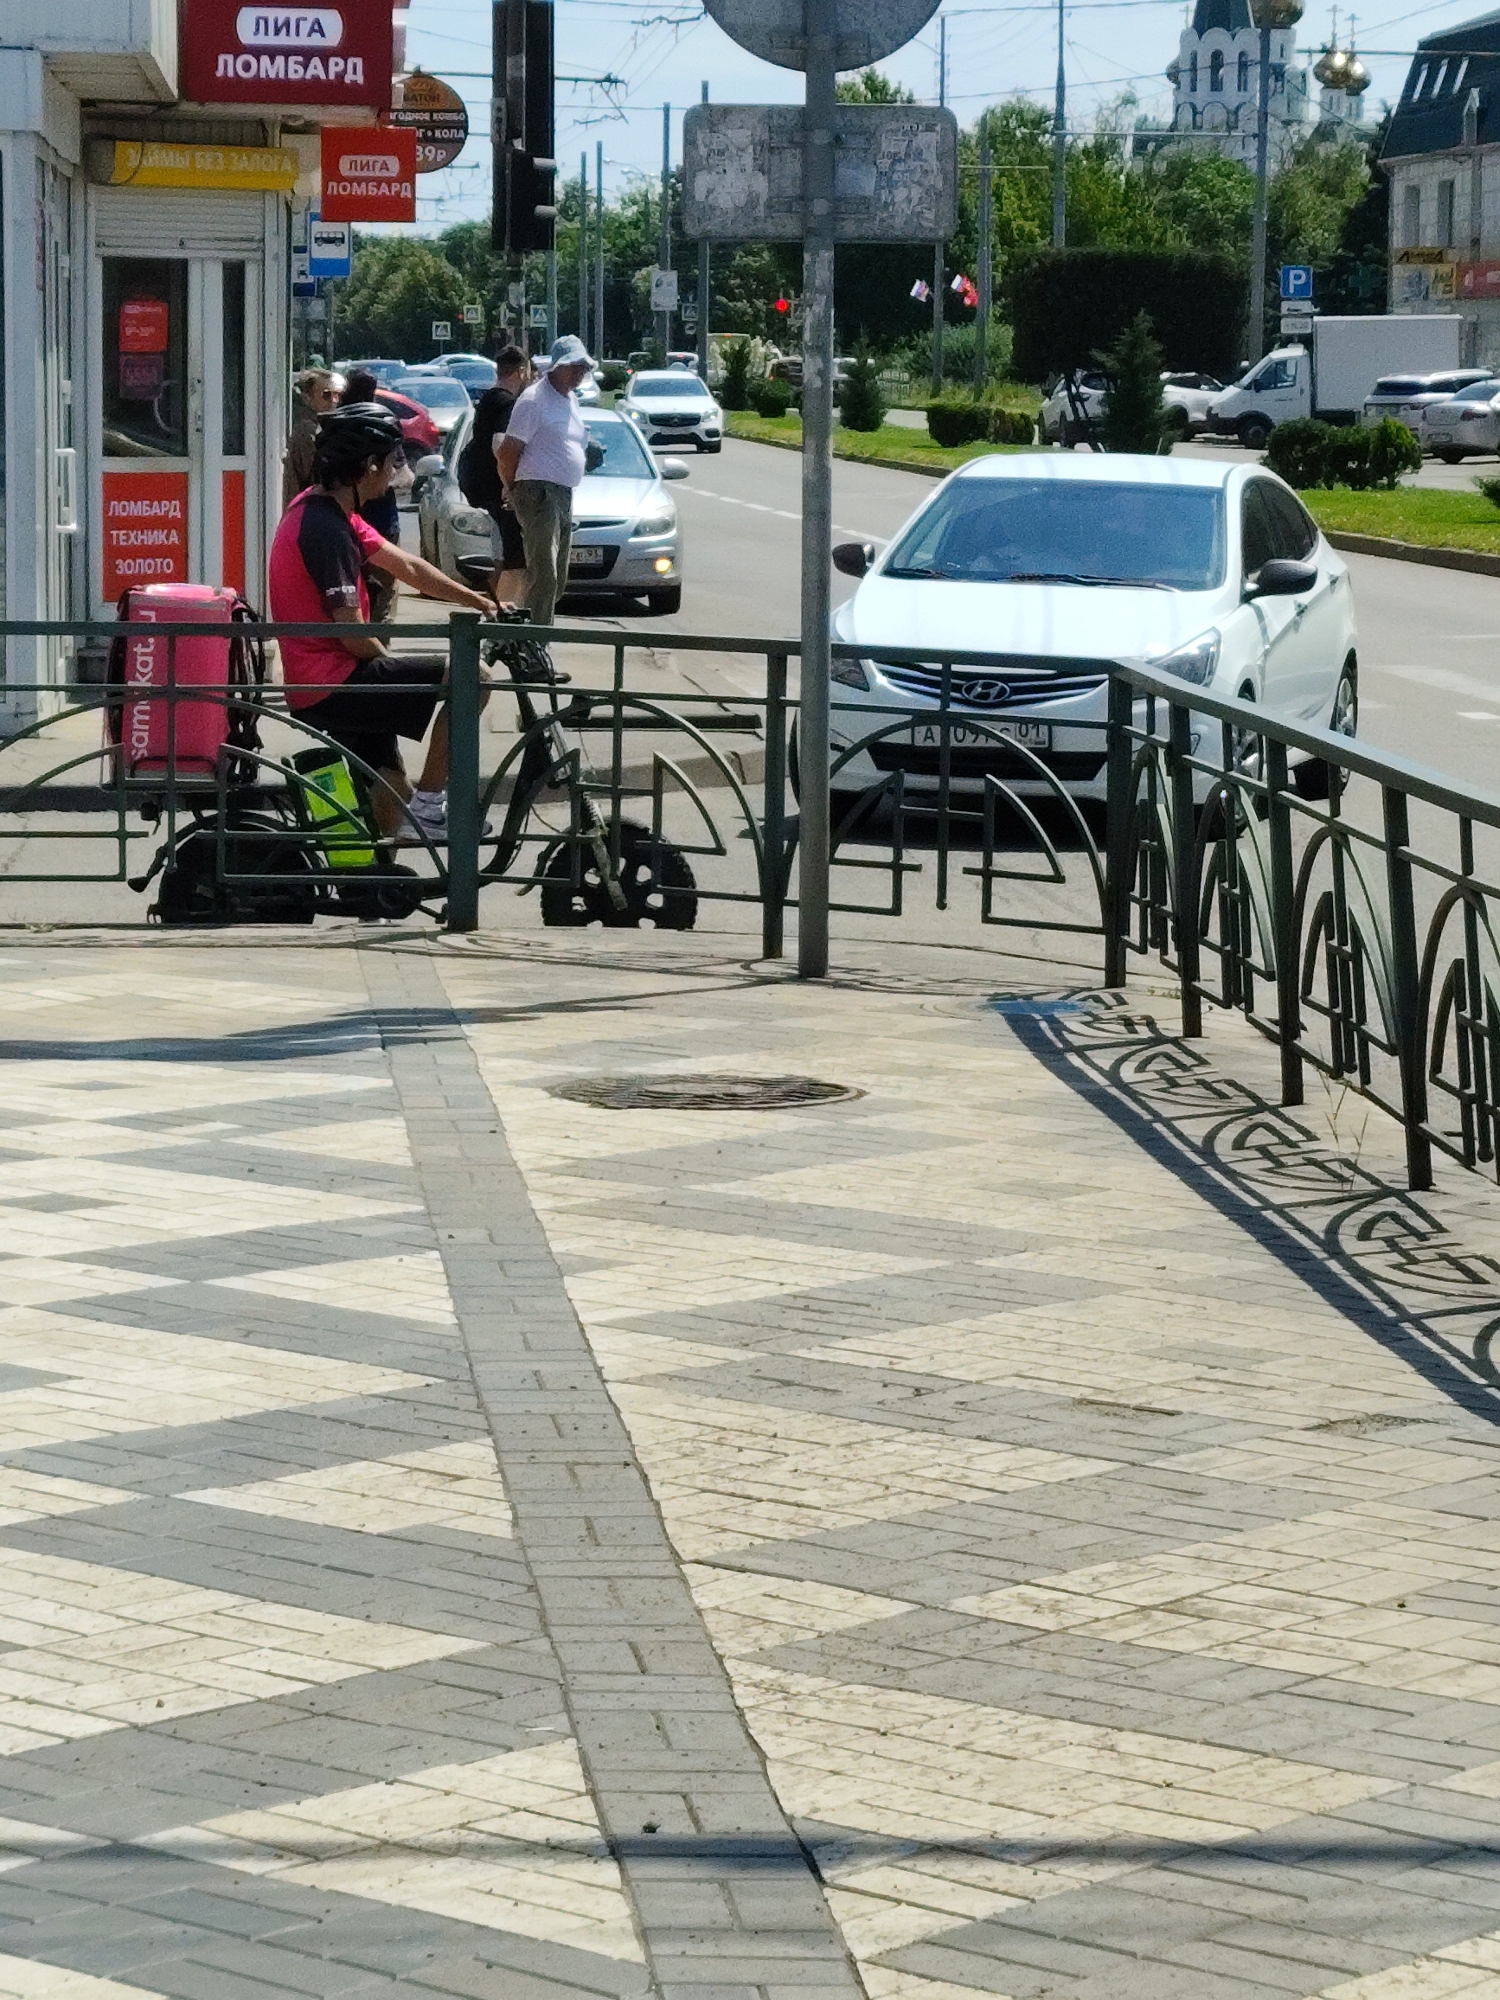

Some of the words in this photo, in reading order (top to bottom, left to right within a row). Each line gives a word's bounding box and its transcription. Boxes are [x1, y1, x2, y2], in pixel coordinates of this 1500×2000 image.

[252, 15, 327, 39] ЛИГА
[214, 53, 365, 85] ЛОМБАРД
[434, 128, 466, 139] КОЛА
[348, 159, 391, 173] ЛИГА
[326, 180, 412, 199] ЛОМБАРД
[1288, 269, 1307, 294] P
[108, 500, 182, 518] ЛОМБАРД
[109, 529, 180, 546] ТЕХНИКА
[114, 558, 174, 575] ЗОЛОТО
